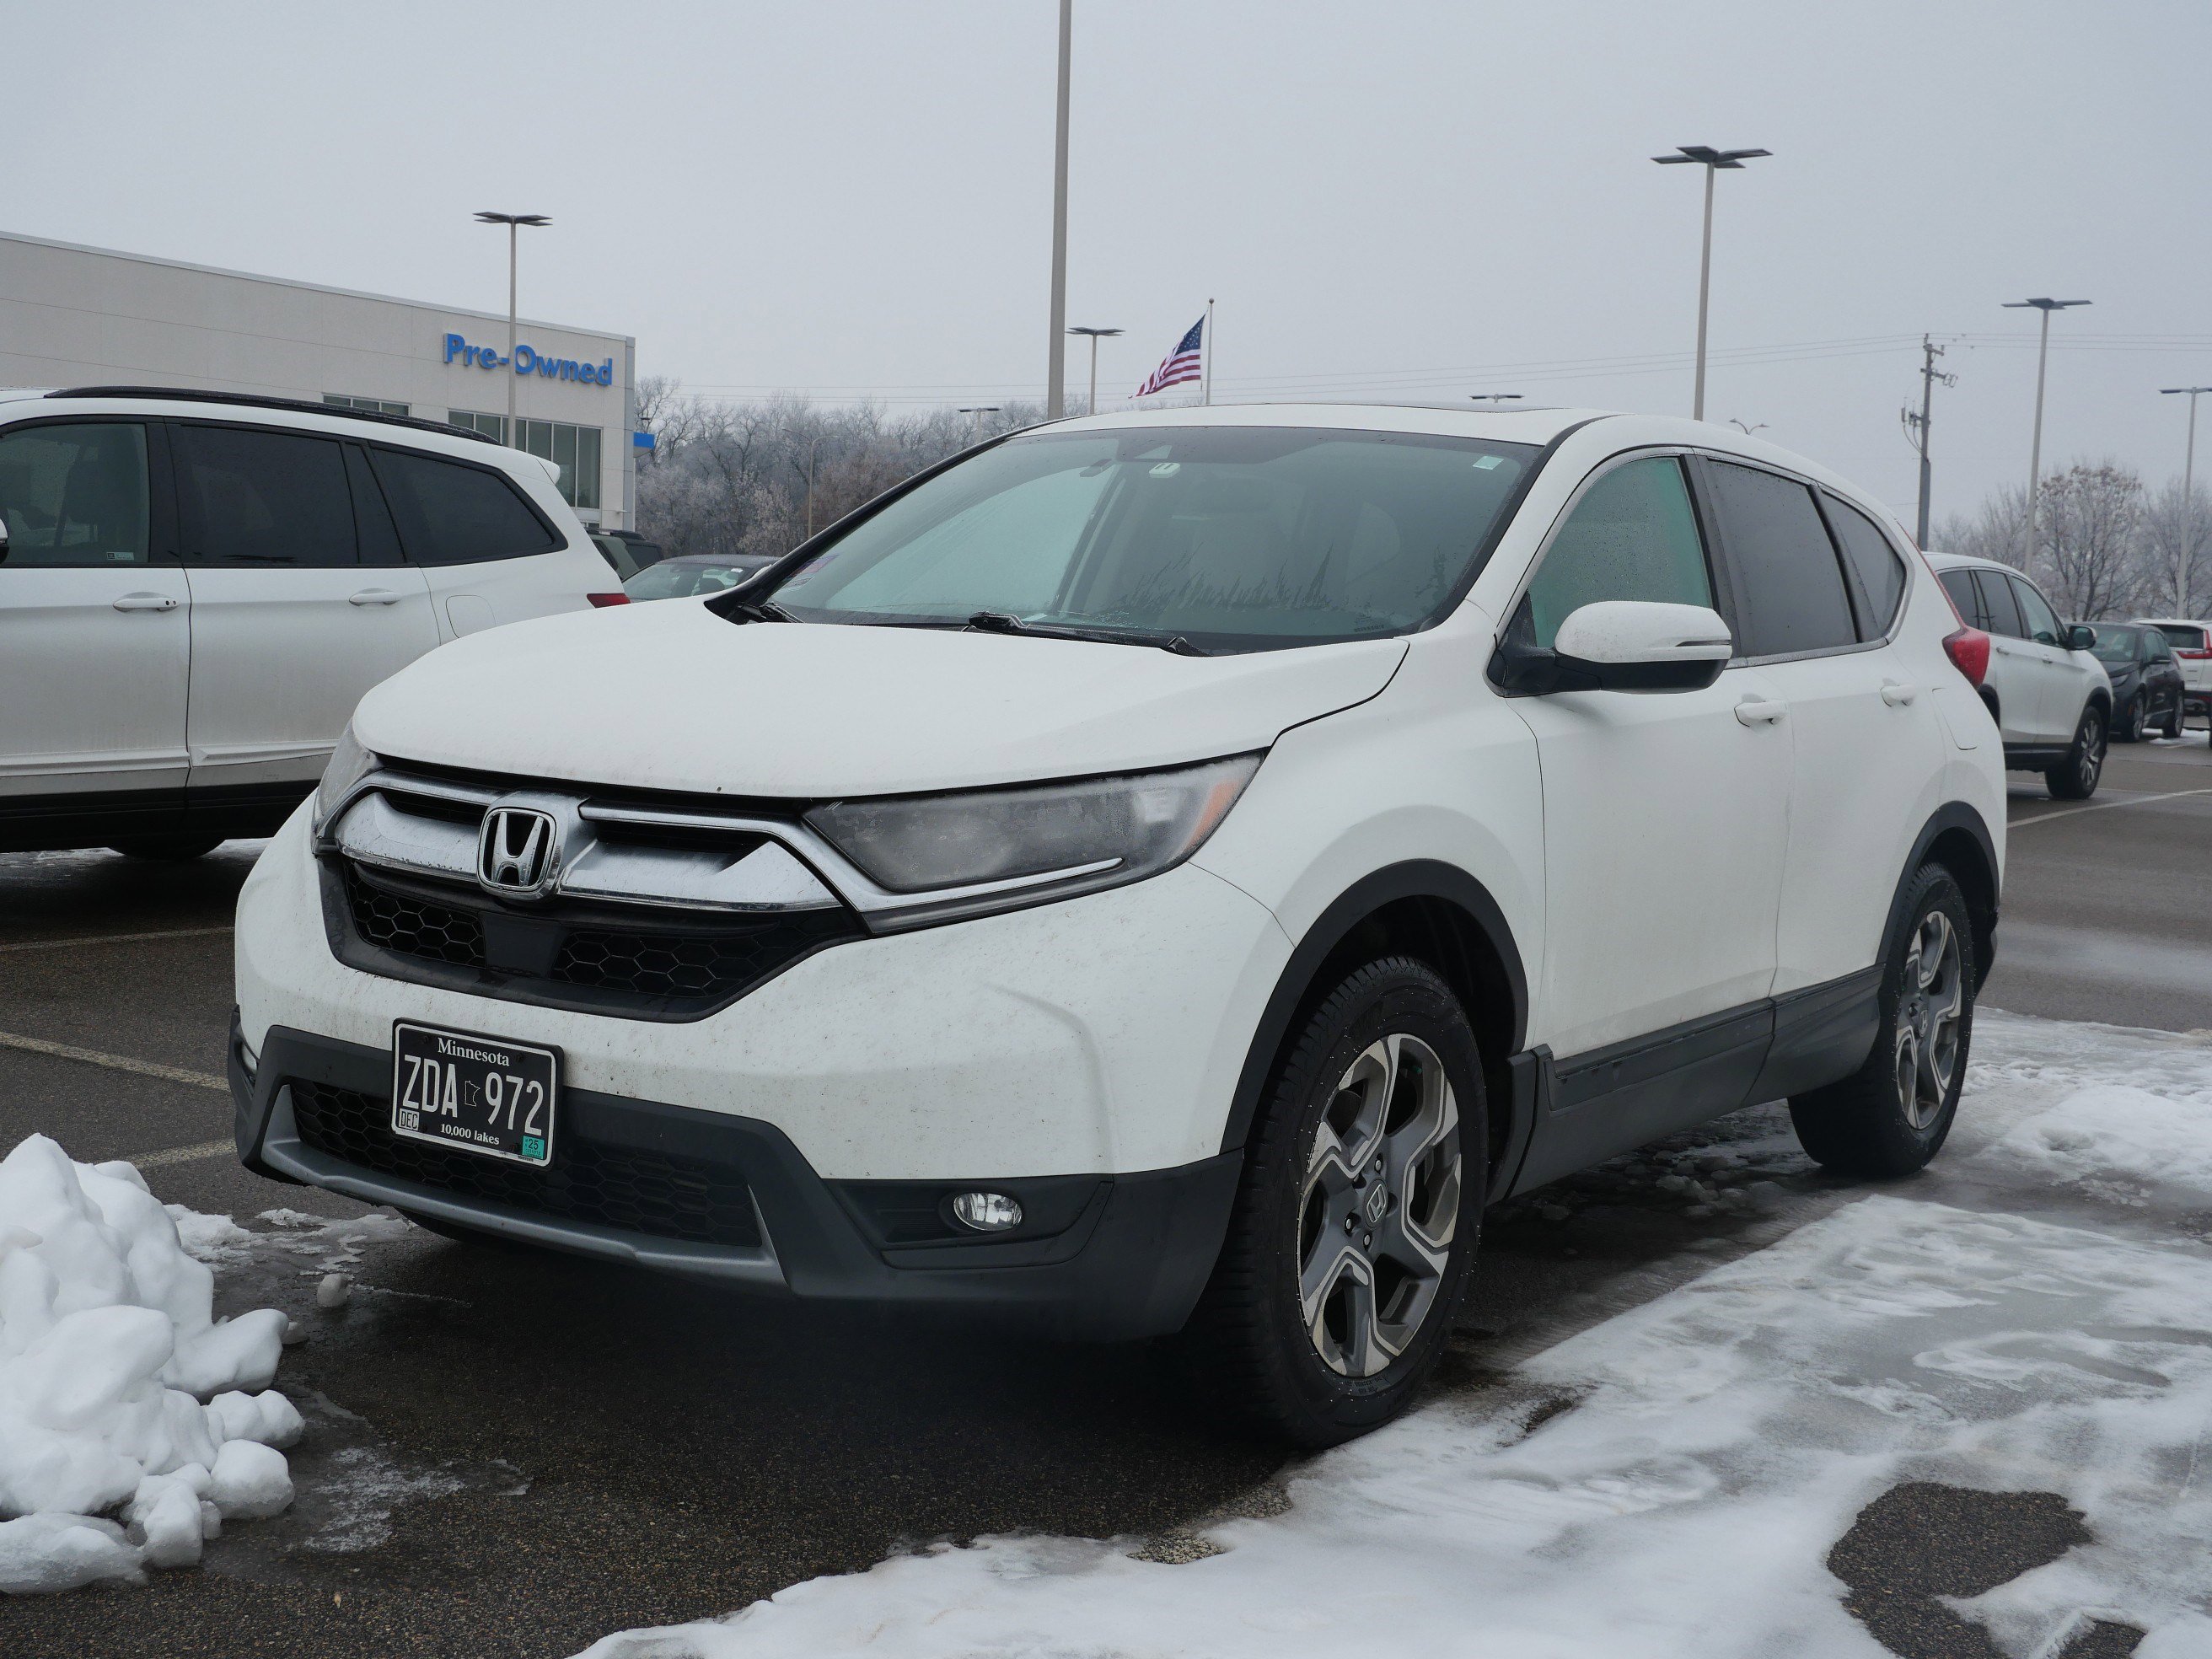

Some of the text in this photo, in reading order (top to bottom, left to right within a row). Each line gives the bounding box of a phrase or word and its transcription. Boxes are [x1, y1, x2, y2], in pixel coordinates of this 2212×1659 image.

[443, 332, 613, 386] Pre-Owned
[437, 1037, 510, 1066] Minnesota
[402, 1054, 544, 1136] ZDA 972
[400, 1110, 418, 1130] DEC
[440, 1123, 500, 1146] 10,000 lakes
[528, 1139, 539, 1150] 25
